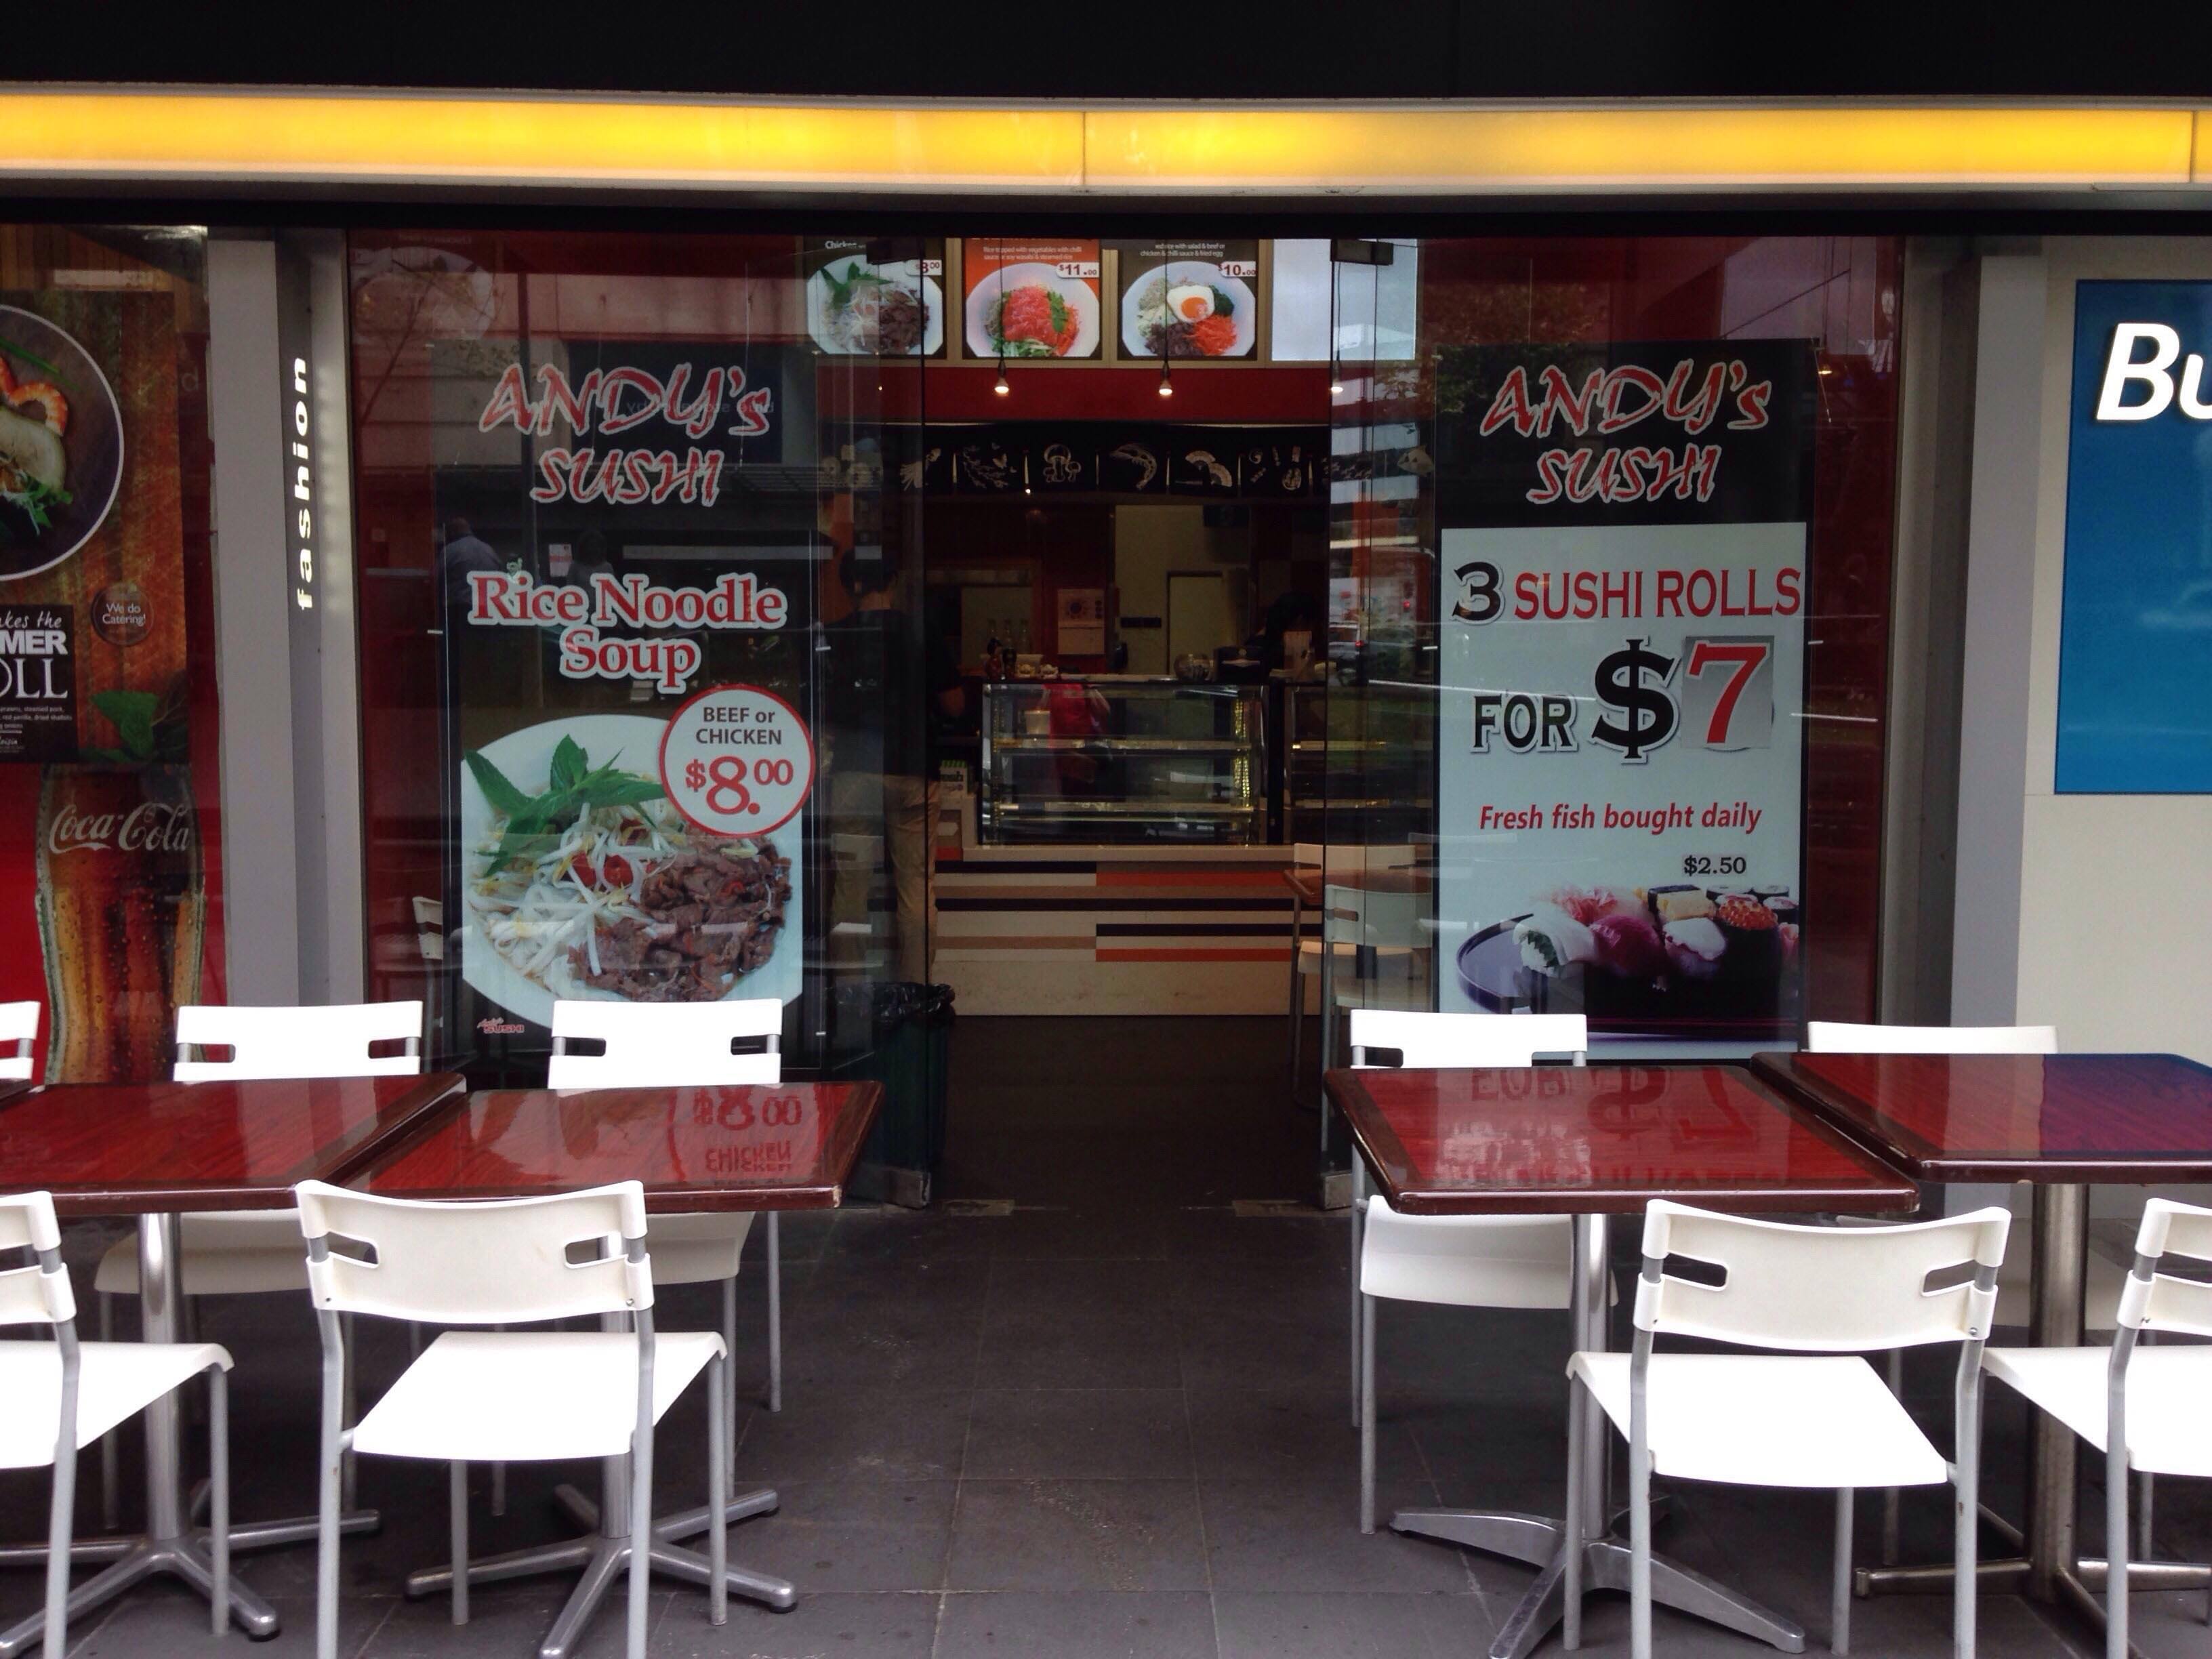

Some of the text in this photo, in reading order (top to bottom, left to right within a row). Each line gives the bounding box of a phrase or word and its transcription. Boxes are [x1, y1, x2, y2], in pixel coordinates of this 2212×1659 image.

[1059, 264, 1097, 276] $11.00
[1218, 264, 1256, 276] $10.00
[293, 357, 313, 611] fashion
[531, 447, 724, 507] SUSHI
[1525, 442, 1722, 504] SUSHI
[106, 602, 141, 613] We do
[468, 571, 787, 630] Rice Noodle
[1451, 560, 1802, 626] 3 SUSHI ROLLS
[37, 611, 62, 629] the
[0, 630, 68, 655] MER
[559, 623, 701, 694] Soup
[703, 707, 775, 723] BEEF or
[1470, 693, 1579, 754] FOR
[696, 728, 782, 745] CHICKEN
[48, 802, 191, 855] Coca-Cola
[1479, 802, 1763, 835] Fresh fish bought daily
[1683, 855, 1747, 876] $2.50
